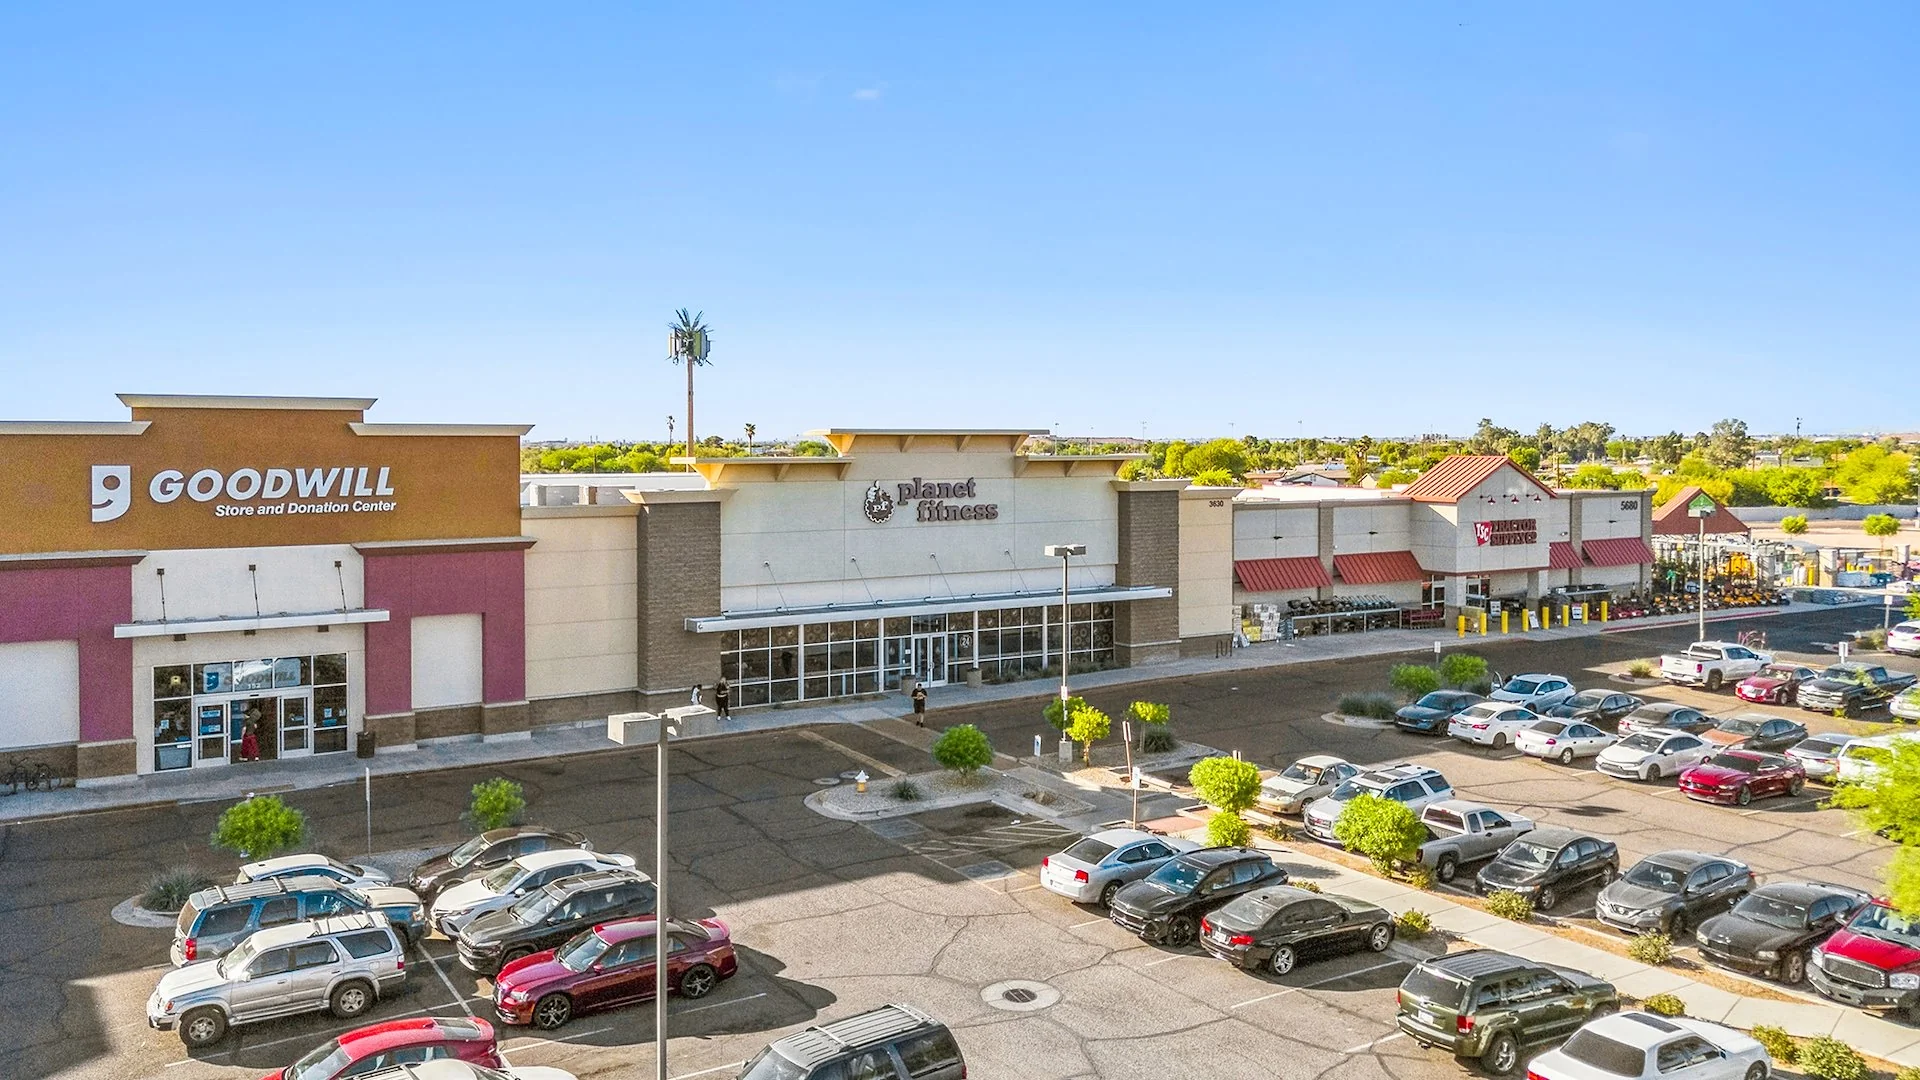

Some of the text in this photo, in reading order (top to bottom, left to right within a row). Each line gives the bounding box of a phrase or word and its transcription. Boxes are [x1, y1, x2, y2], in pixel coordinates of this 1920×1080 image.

[149, 466, 394, 503] GOODWILL
[897, 477, 976, 505] planet
[215, 500, 396, 517] Store and Donation Center
[872, 502, 889, 513] pf
[917, 500, 999, 522] fitness
[1620, 500, 1638, 511] 5680
[1490, 518, 1537, 532] TRACTOR
[1490, 533, 1524, 546] SUPPLY
[962, 637, 970, 646] 24
